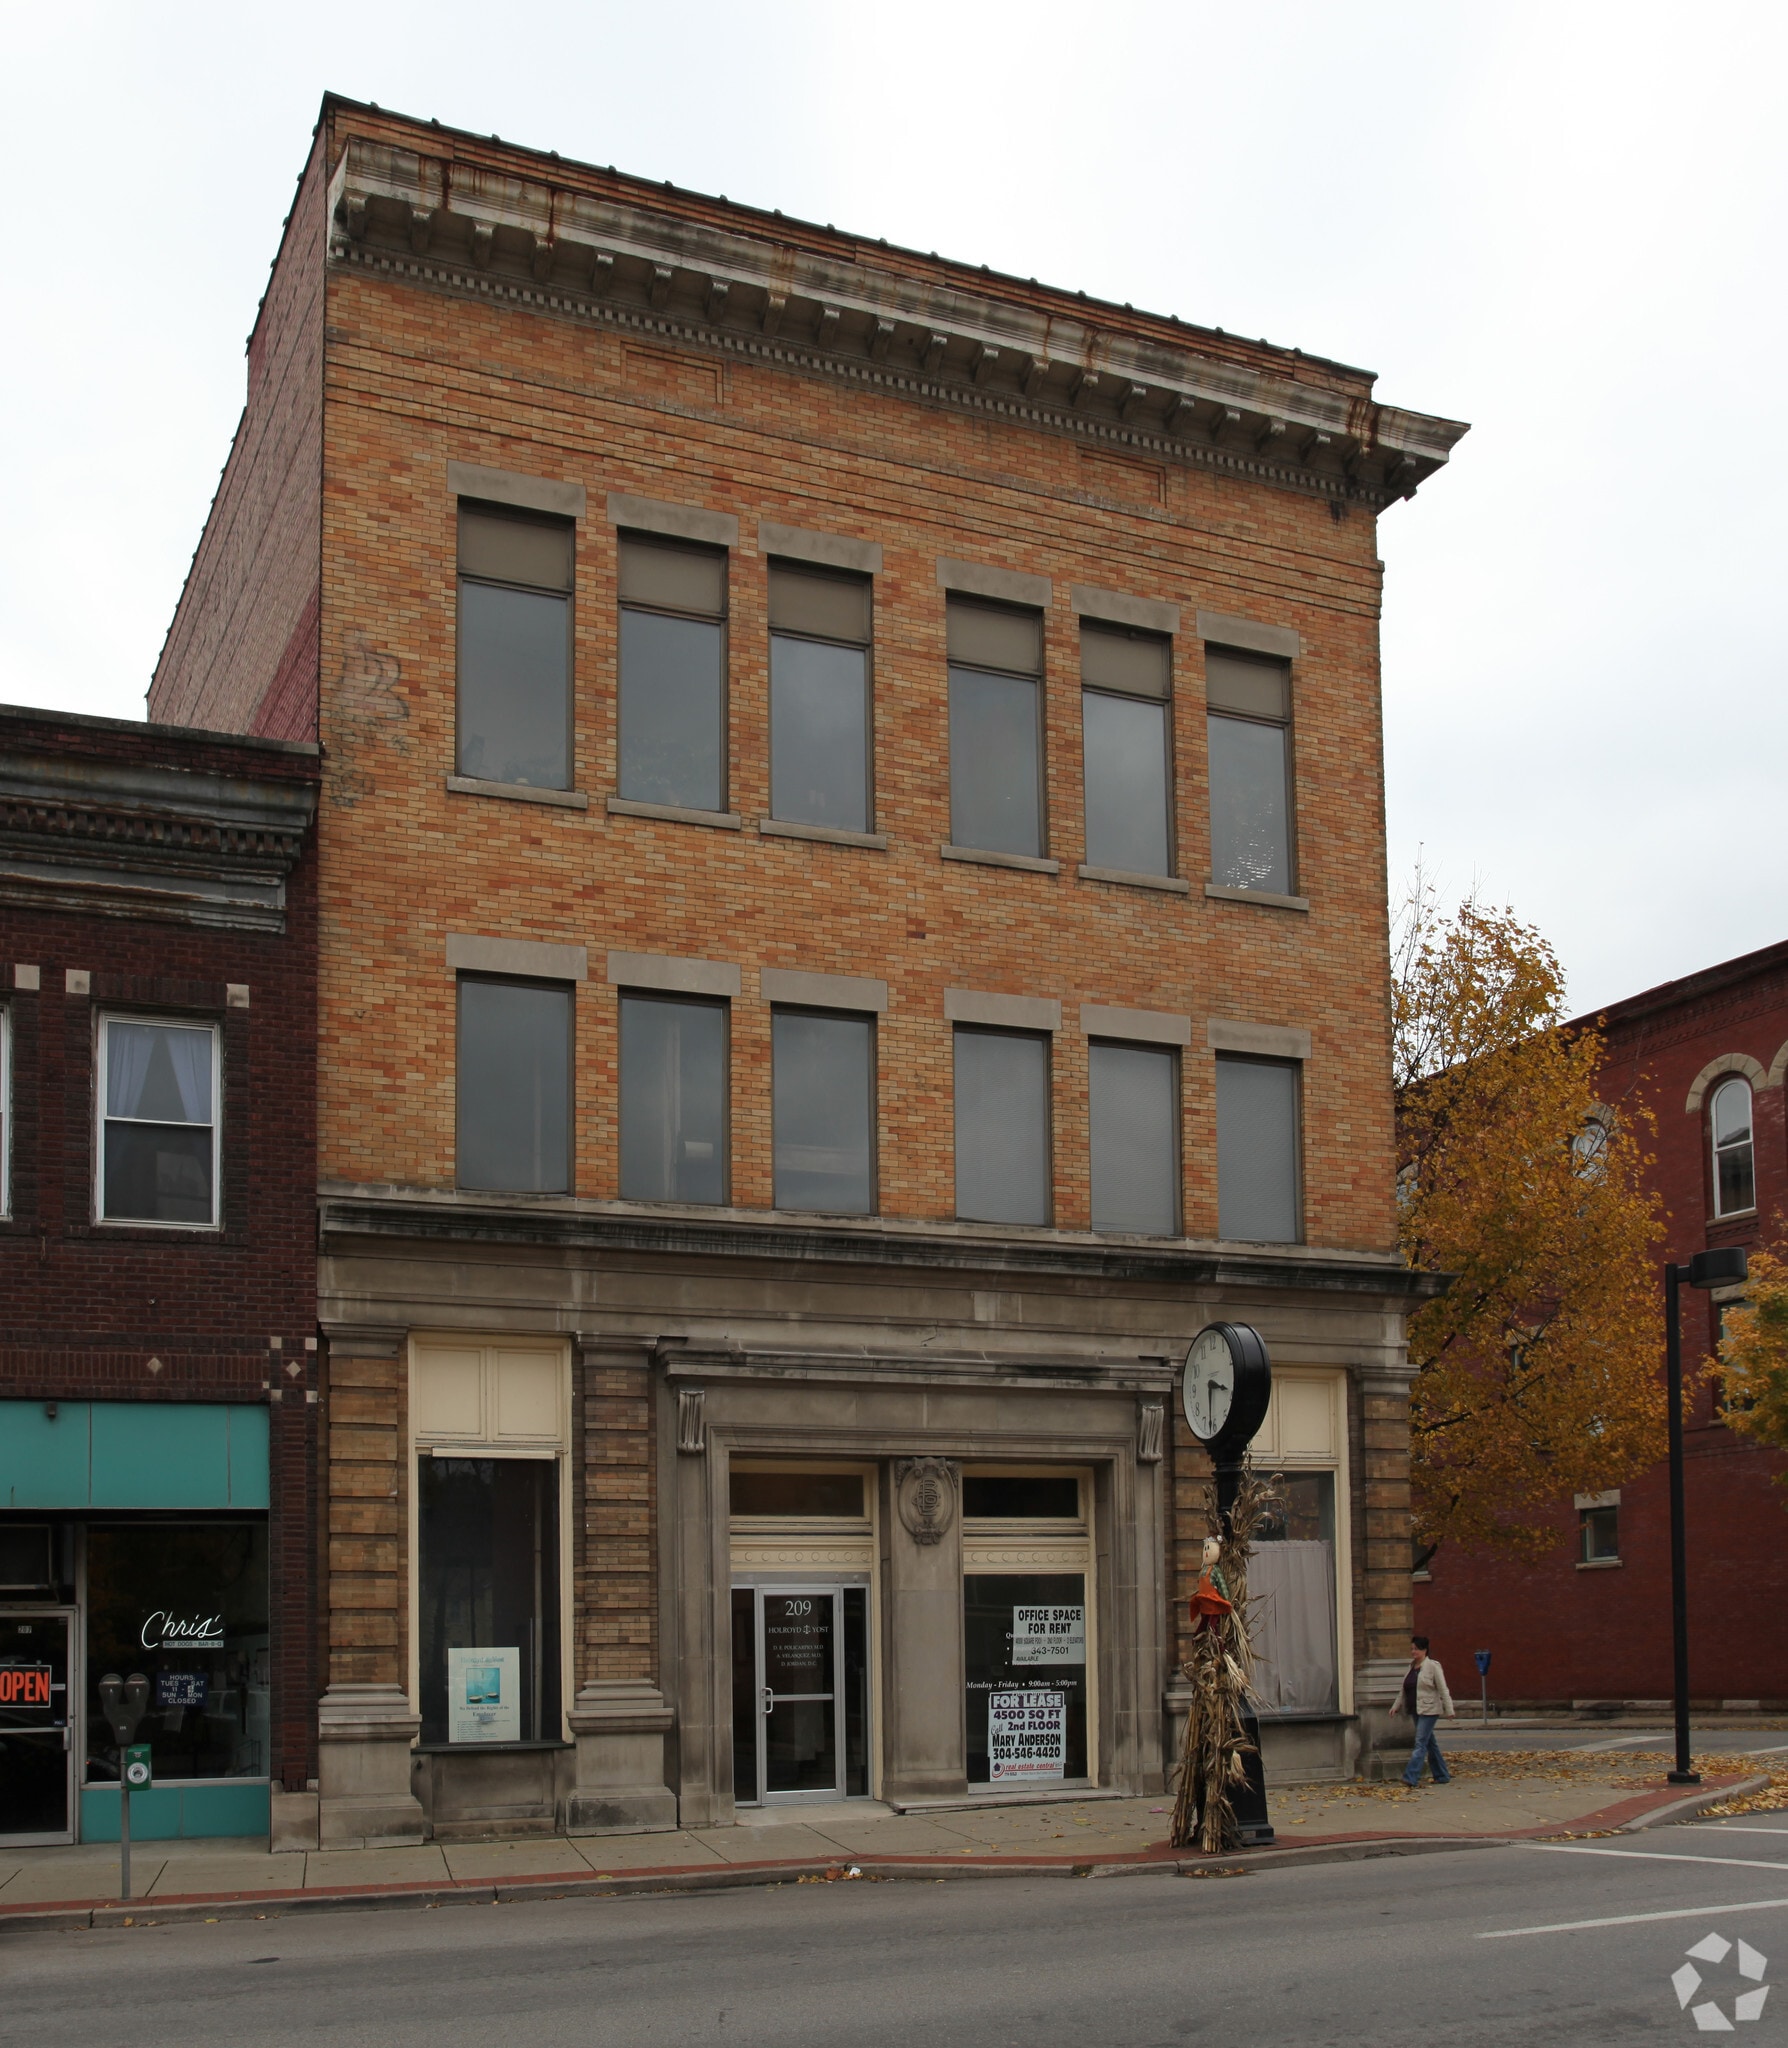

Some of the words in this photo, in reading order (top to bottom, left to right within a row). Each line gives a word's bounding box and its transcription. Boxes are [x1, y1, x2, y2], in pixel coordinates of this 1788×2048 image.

[1210, 1336, 1216, 1350] 12
[1201, 1346, 1206, 1360] 11
[1193, 1364, 1200, 1379] 10
[1192, 1384, 1196, 1398] 9
[1195, 1402, 1200, 1416] 8
[1202, 1416, 1206, 1431] 7
[1213, 1418, 1217, 1432] 6
[786, 1600, 812, 1616] 209
[1018, 1610, 1049, 1621] OFFICE
[1053, 1610, 1081, 1620] SPACE
[142, 1611, 223, 1648] Chris'
[1028, 1623, 1045, 1634] FOR
[1050, 1623, 1072, 1634] RENT
[1031, 1647, 1069, 1655] 343-7501
[0, 1671, 49, 1702] OPEN
[966, 1682, 992, 1690] Monday
[998, 1681, 1019, 1689] Friday
[1056, 1680, 1077, 1688] 5:00pm
[993, 1695, 1020, 1708] FOR
[1023, 1694, 1061, 1708] LEASE
[994, 1710, 1025, 1719] 4500
[1028, 1710, 1045, 1720] SQ
[1048, 1710, 1061, 1719] FT
[991, 1724, 1003, 1736] Call
[1008, 1722, 1025, 1730] 2nd
[1028, 1721, 1060, 1730] FLOOR
[993, 1734, 1015, 1747] MARY
[1018, 1733, 1060, 1746] ANDERSON
